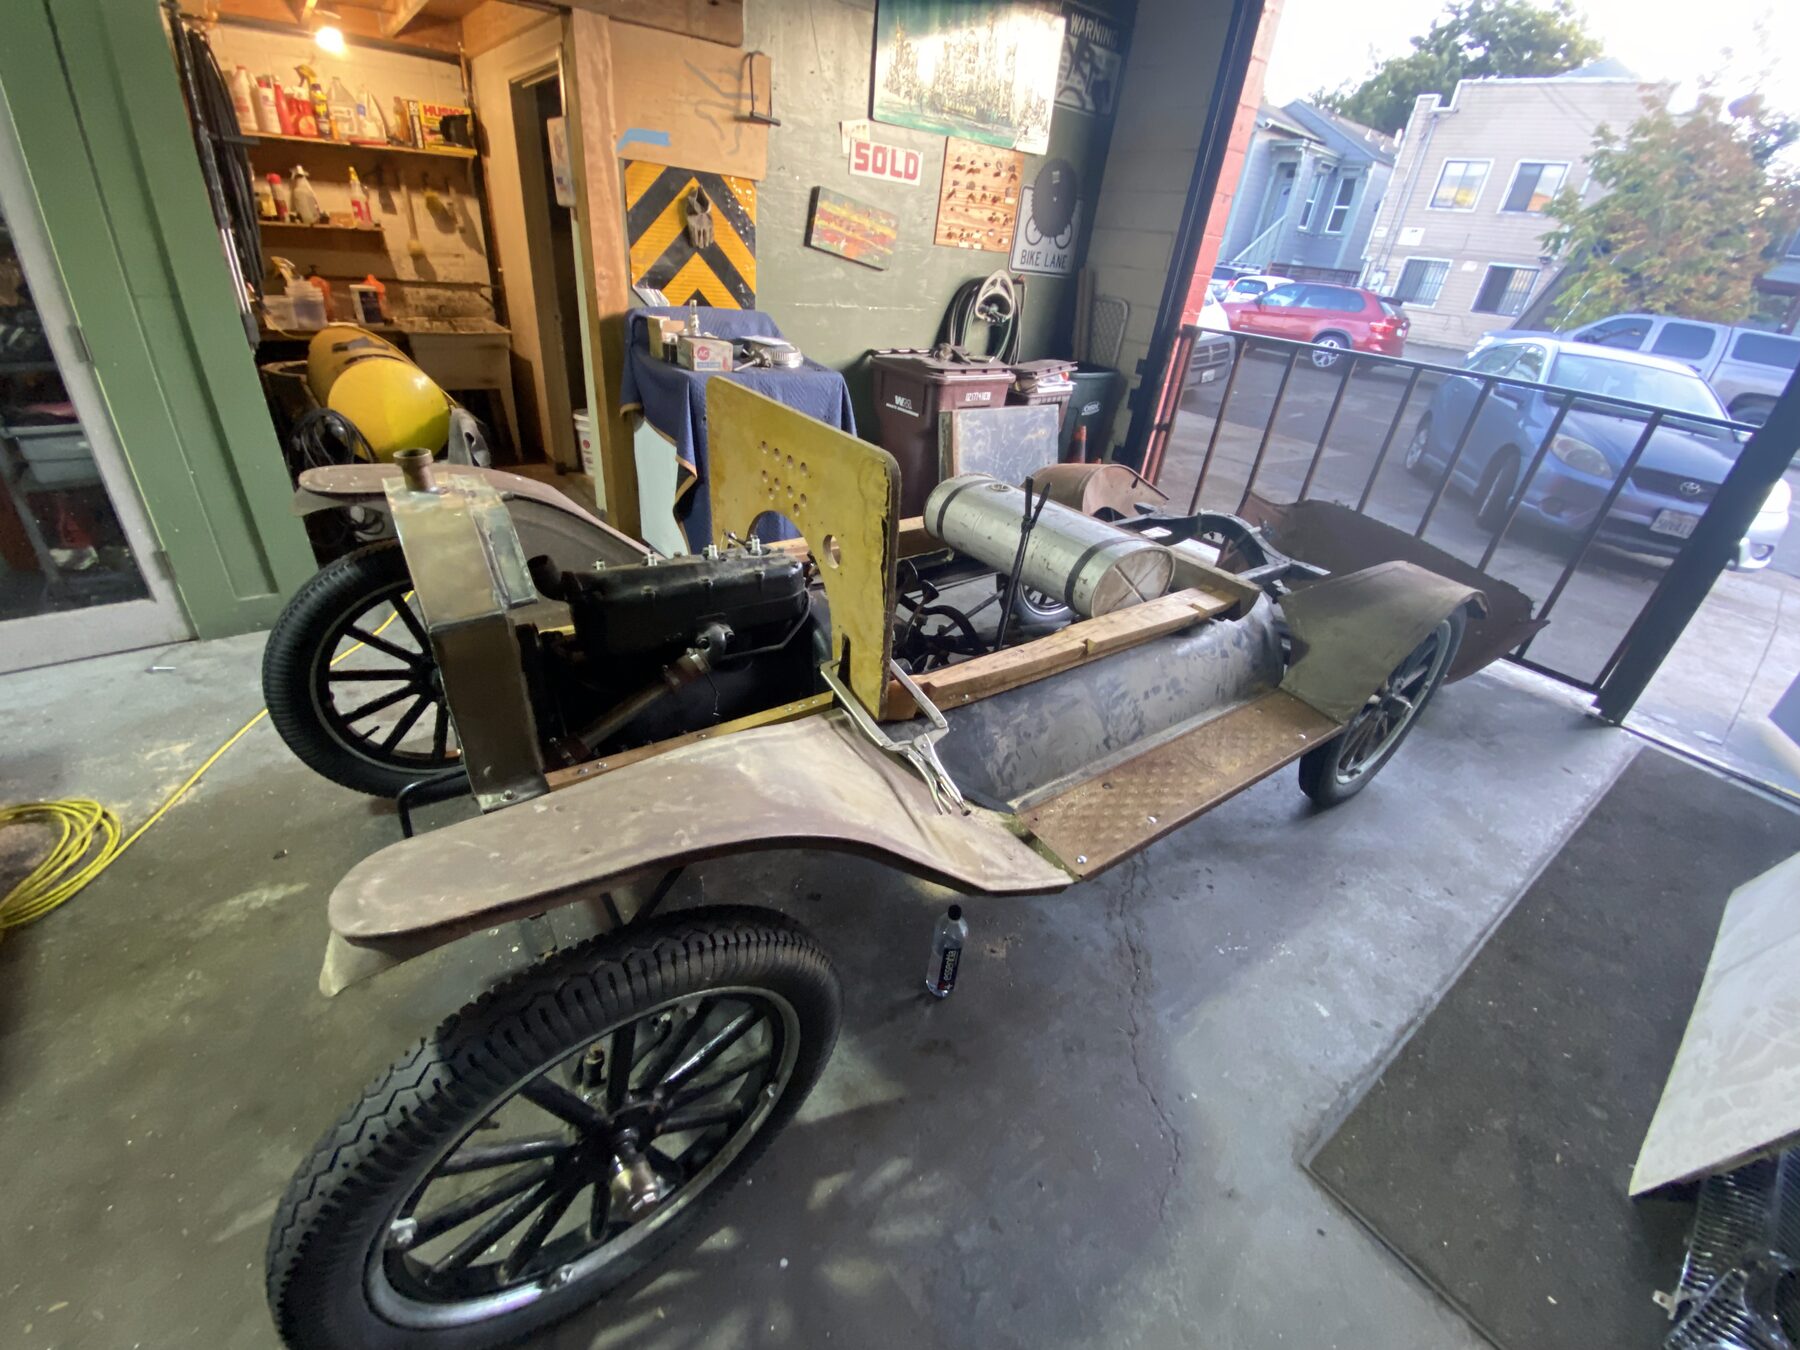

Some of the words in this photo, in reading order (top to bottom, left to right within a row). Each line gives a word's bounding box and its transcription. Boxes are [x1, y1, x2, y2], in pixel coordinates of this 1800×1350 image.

[1070, 12, 1119, 50] WARNING
[854, 141, 919, 180] SOLD
[1020, 249, 1041, 266] BIKE
[1044, 253, 1067, 269] LANE
